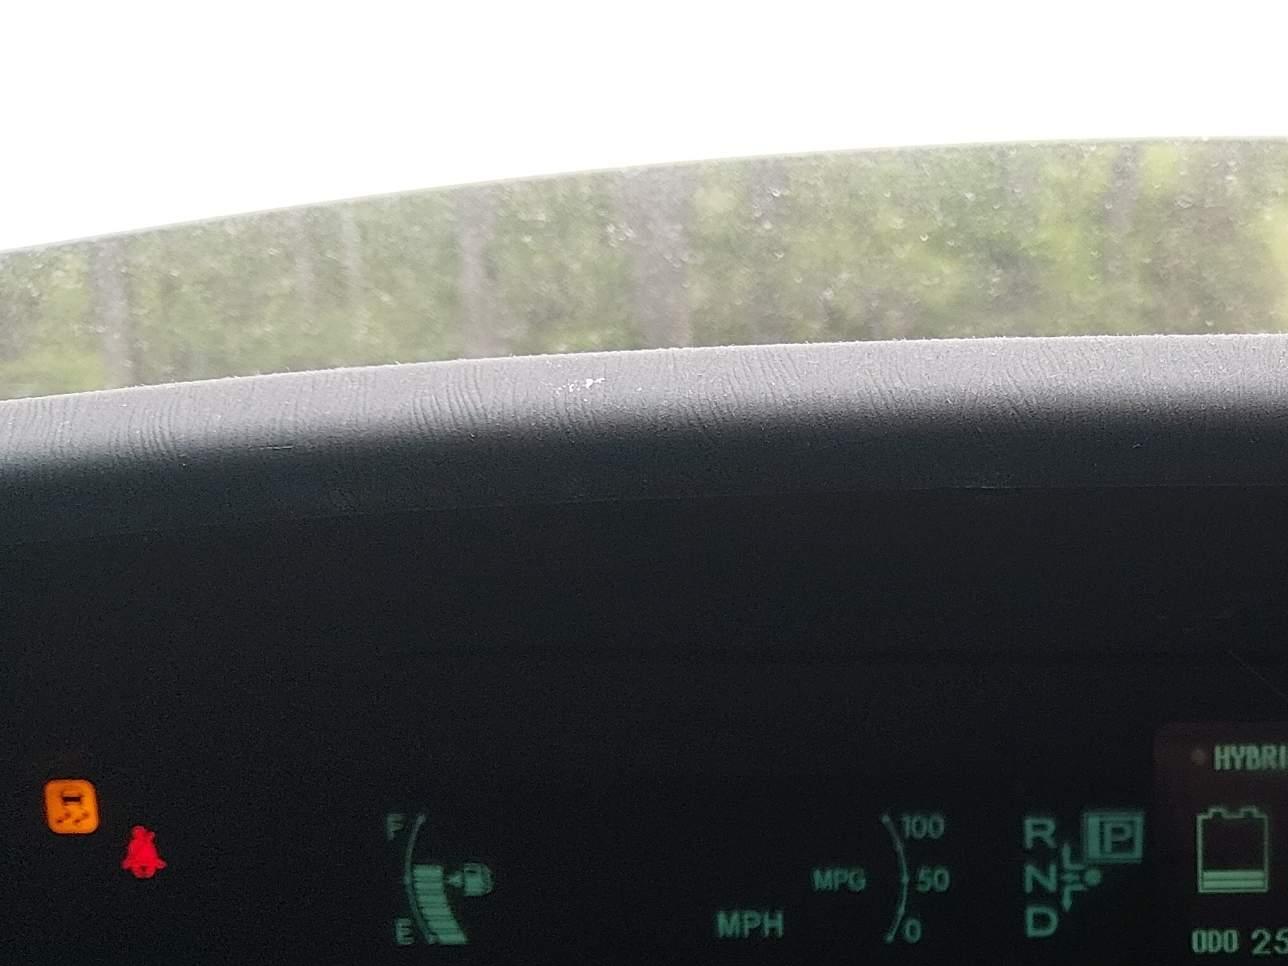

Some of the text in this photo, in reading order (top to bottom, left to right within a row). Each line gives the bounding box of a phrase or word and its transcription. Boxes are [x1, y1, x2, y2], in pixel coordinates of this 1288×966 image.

[386, 813, 407, 840] F
[901, 813, 945, 840] 100
[1024, 817, 1056, 849] R
[811, 866, 867, 893] MPG
[915, 865, 951, 893] 50
[1024, 864, 1056, 894] N
[395, 916, 415, 945] E
[716, 910, 785, 939] MPH
[902, 917, 922, 944] 0
[1025, 905, 1058, 938] D
[1191, 927, 1239, 954] ODO
